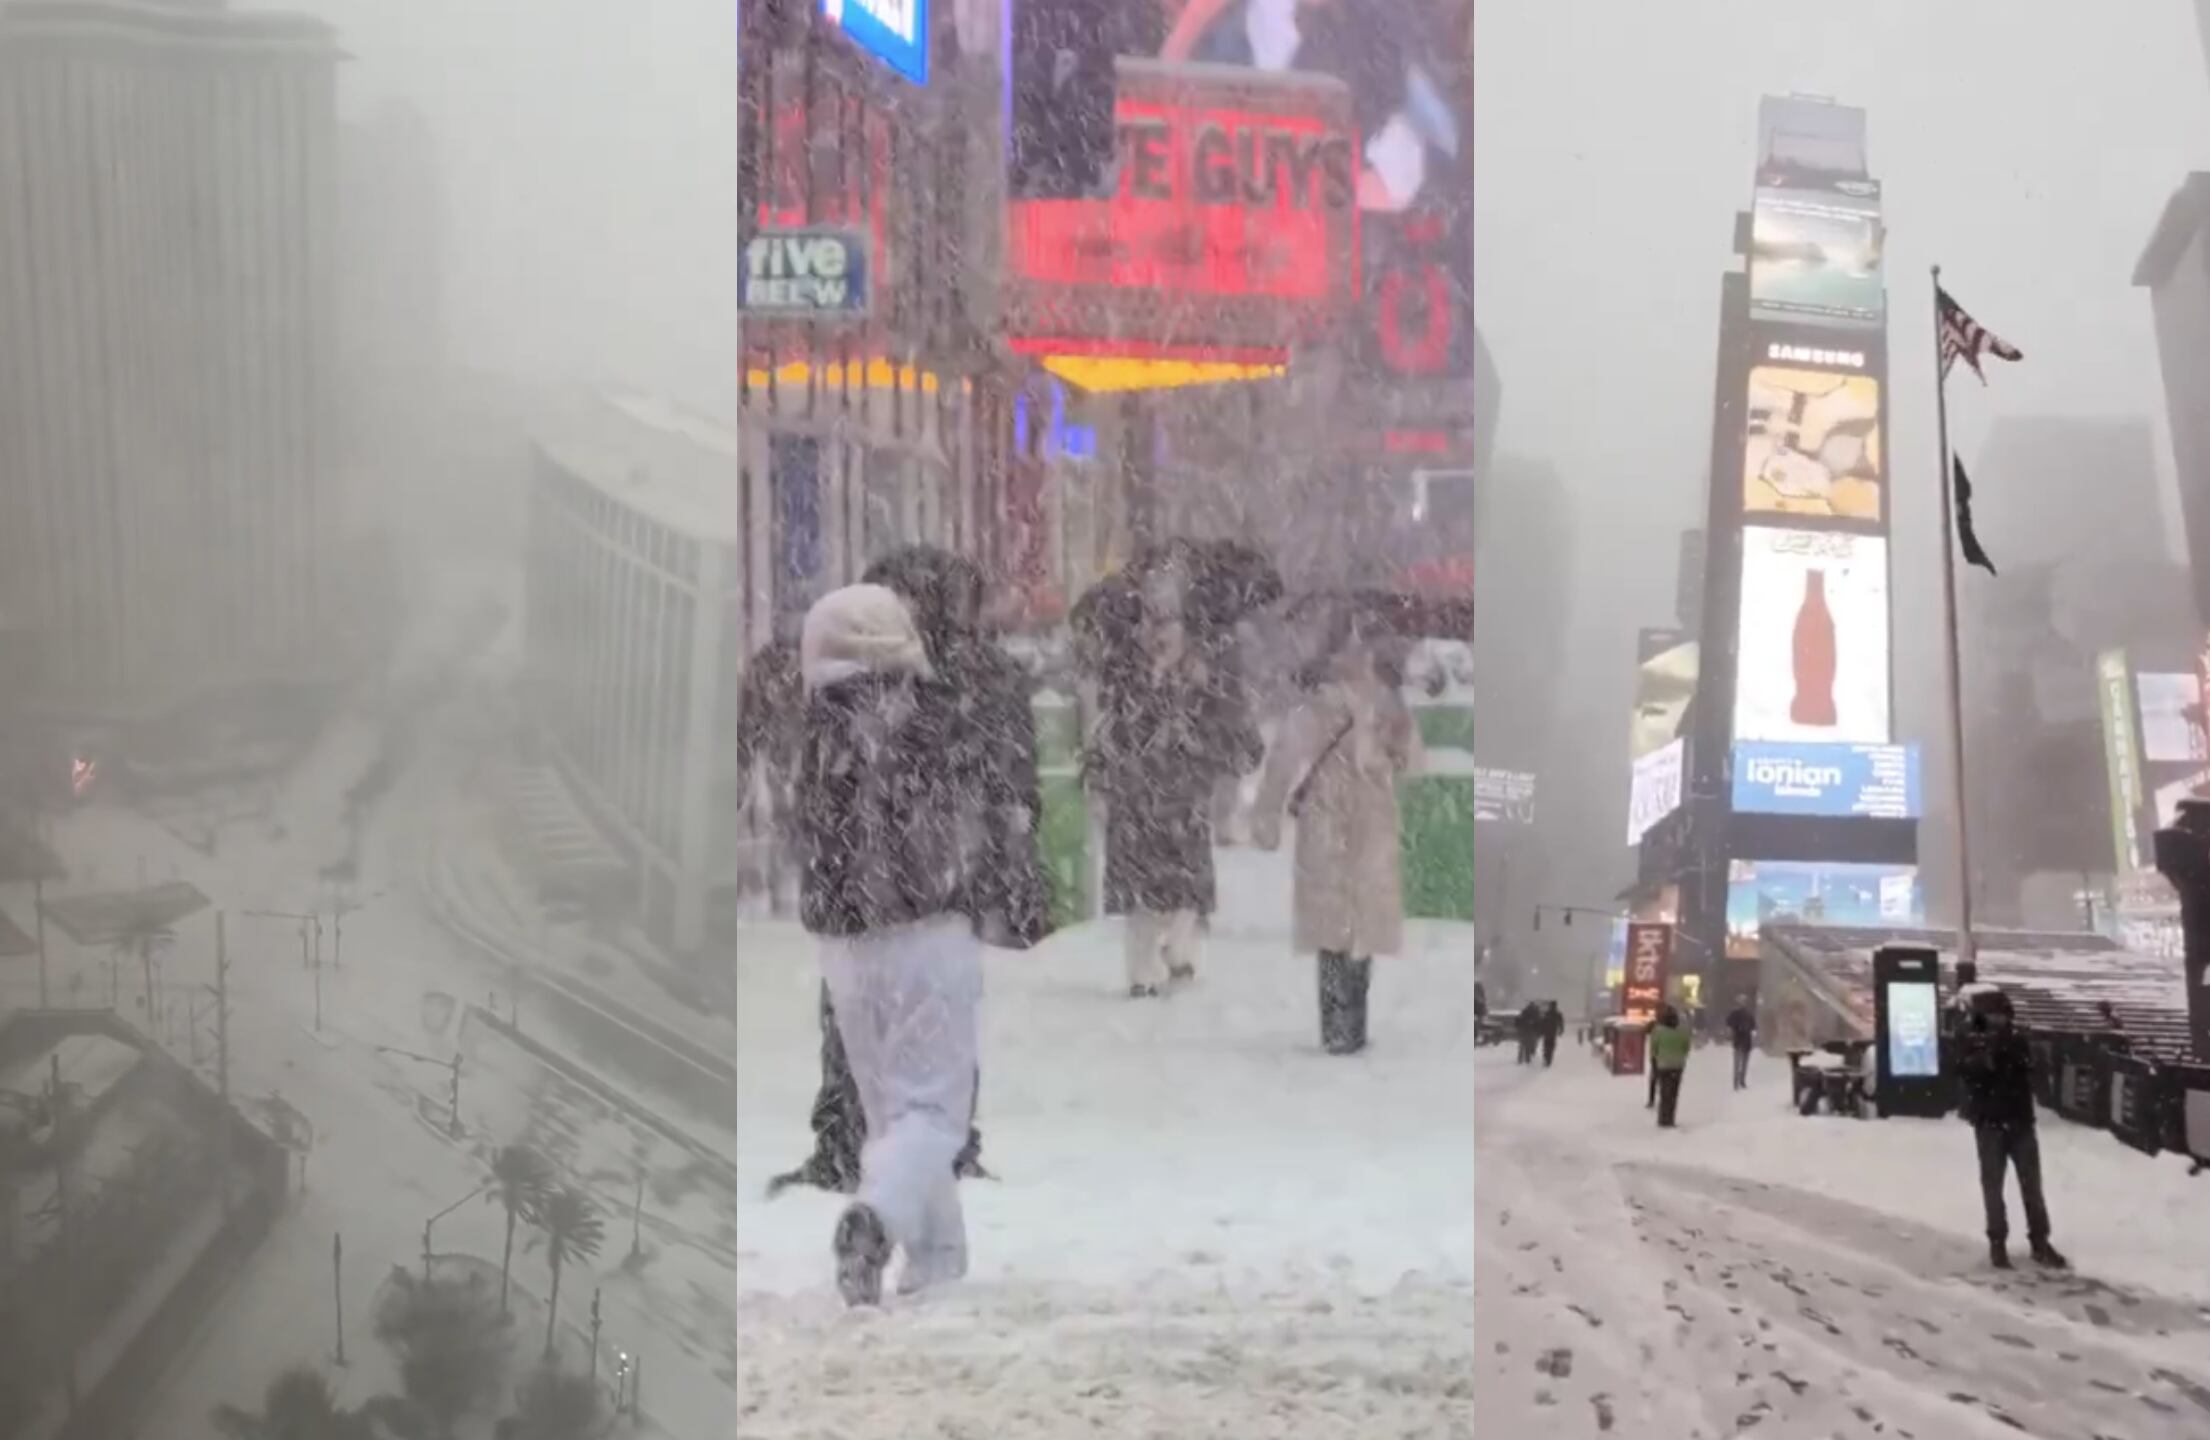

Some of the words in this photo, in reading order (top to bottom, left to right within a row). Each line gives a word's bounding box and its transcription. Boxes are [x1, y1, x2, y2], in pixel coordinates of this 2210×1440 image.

[1194, 119, 1352, 209] GUYS
[746, 238, 847, 275] five
[1768, 343, 1864, 367] SAMSUNG
